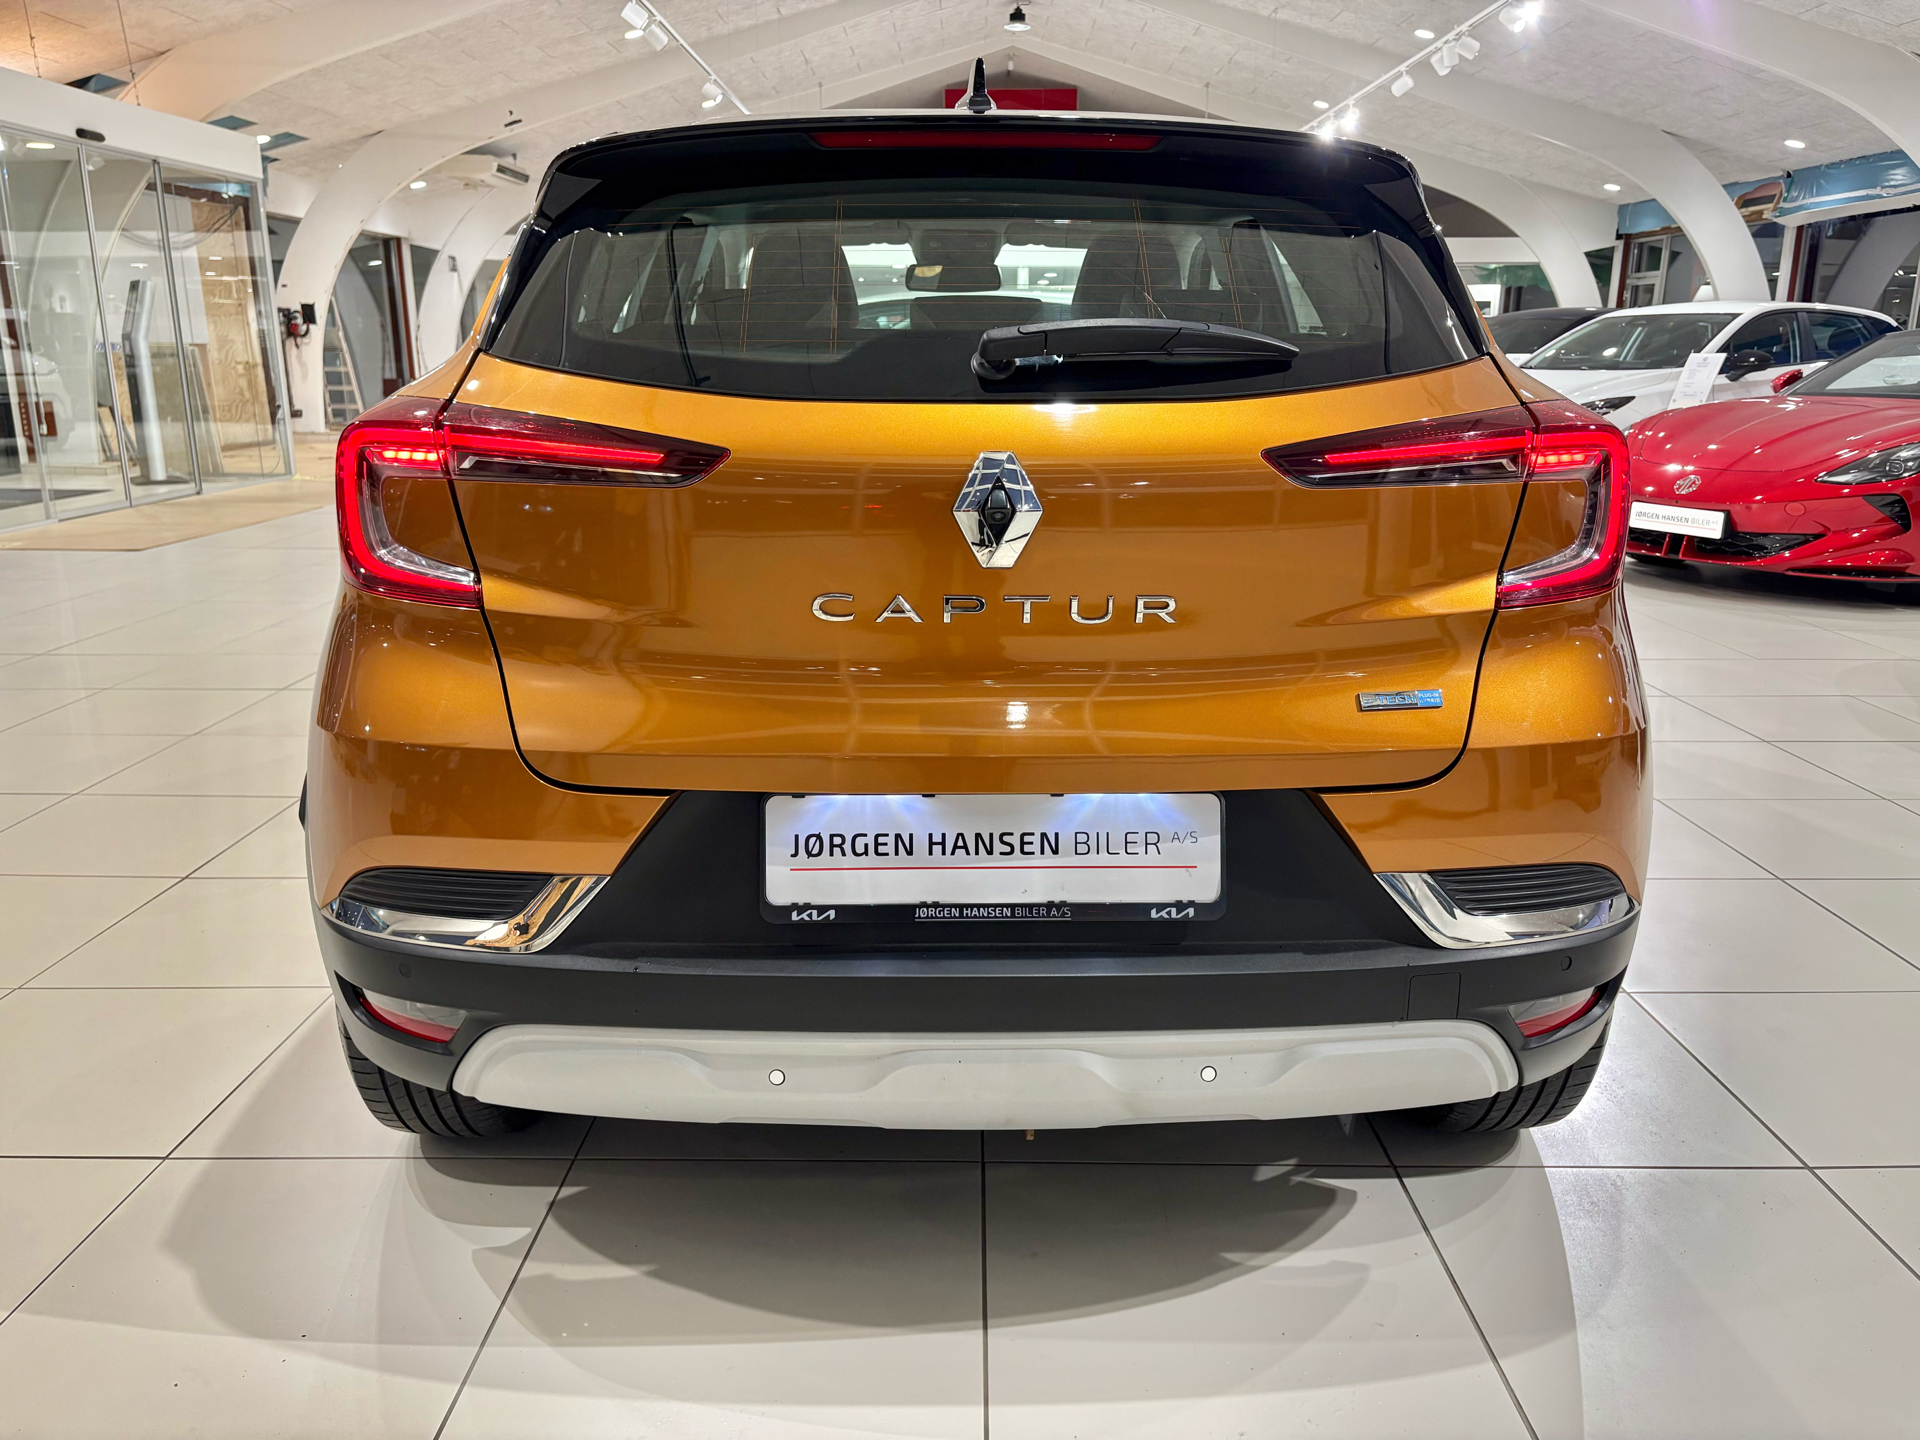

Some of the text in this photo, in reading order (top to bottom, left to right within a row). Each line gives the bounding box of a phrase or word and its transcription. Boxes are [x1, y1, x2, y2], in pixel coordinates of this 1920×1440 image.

[1635, 511, 1660, 520] JØRGEN
[1661, 514, 1690, 524] HANSEN
[1690, 517, 1710, 527] BILER
[811, 593, 1177, 623] CAPTUR
[790, 830, 1199, 858] JØRGEN HANSEN BILER A/S
[914, 906, 1071, 918] JØRGEN HANSEN BILER A/S
